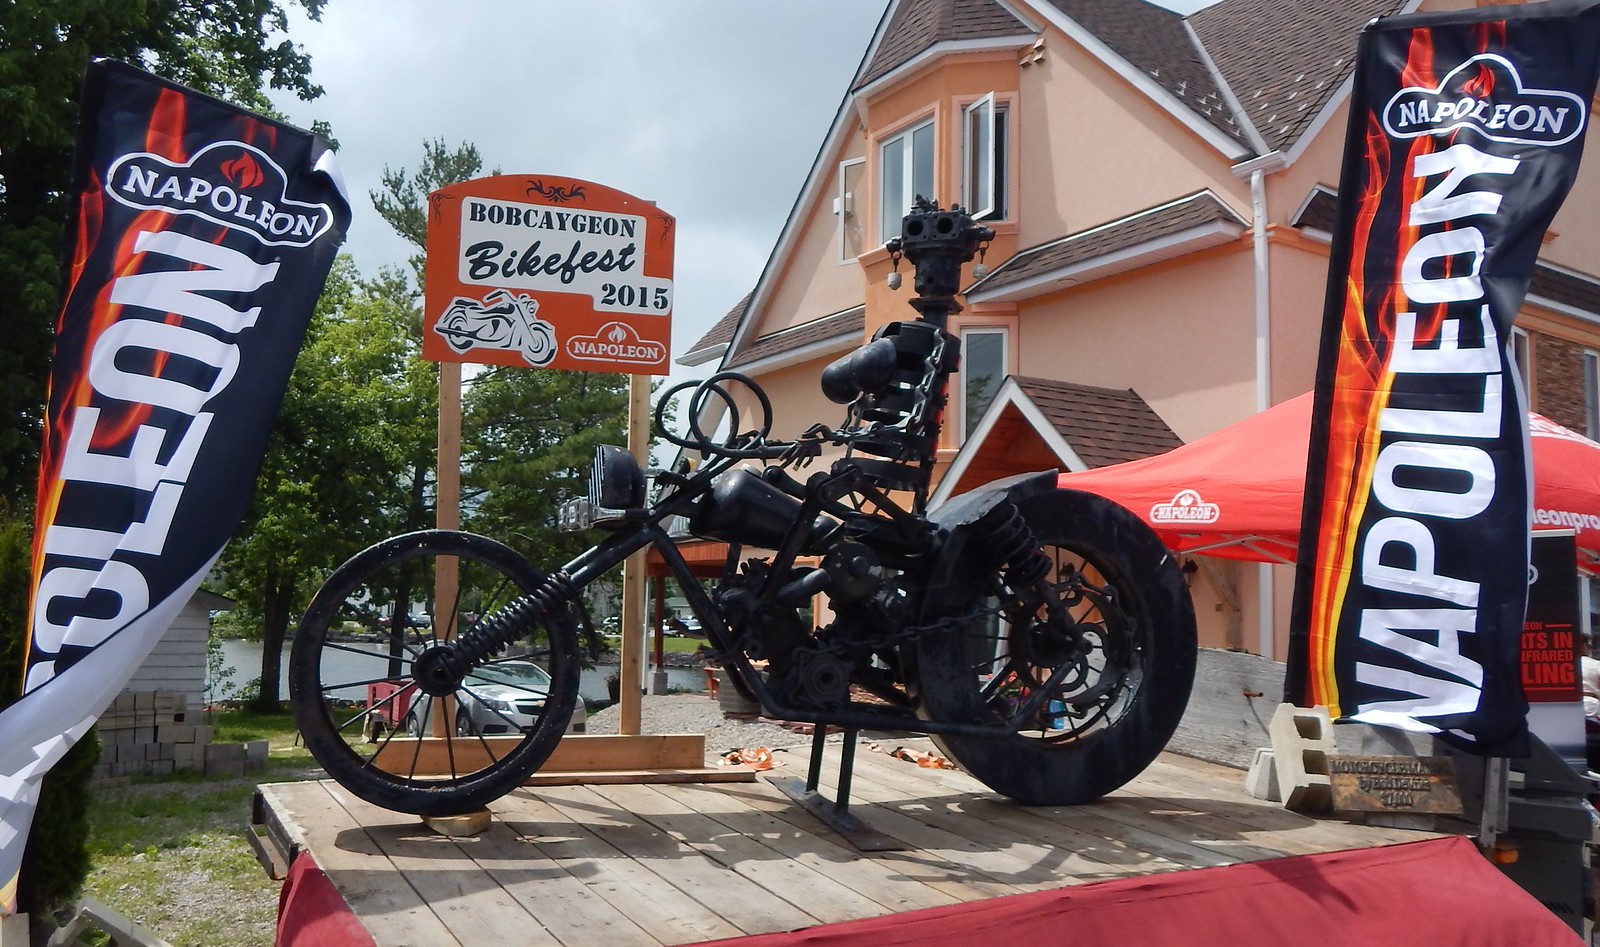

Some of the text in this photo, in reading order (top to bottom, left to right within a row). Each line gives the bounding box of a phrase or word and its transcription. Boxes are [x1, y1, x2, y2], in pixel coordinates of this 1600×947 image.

[1398, 97, 1569, 134] NAPOLEON
[122, 165, 320, 237] NAPOLEON
[469, 202, 637, 238] BOBCAYGEON
[464, 240, 637, 285] Bikefest
[601, 283, 669, 310] 2015
[574, 341, 660, 360] NAPOLEON
[25, 230, 281, 694] OLEON
[1157, 506, 1212, 520] NAPOLEON
[1552, 631, 1573, 648] IN
